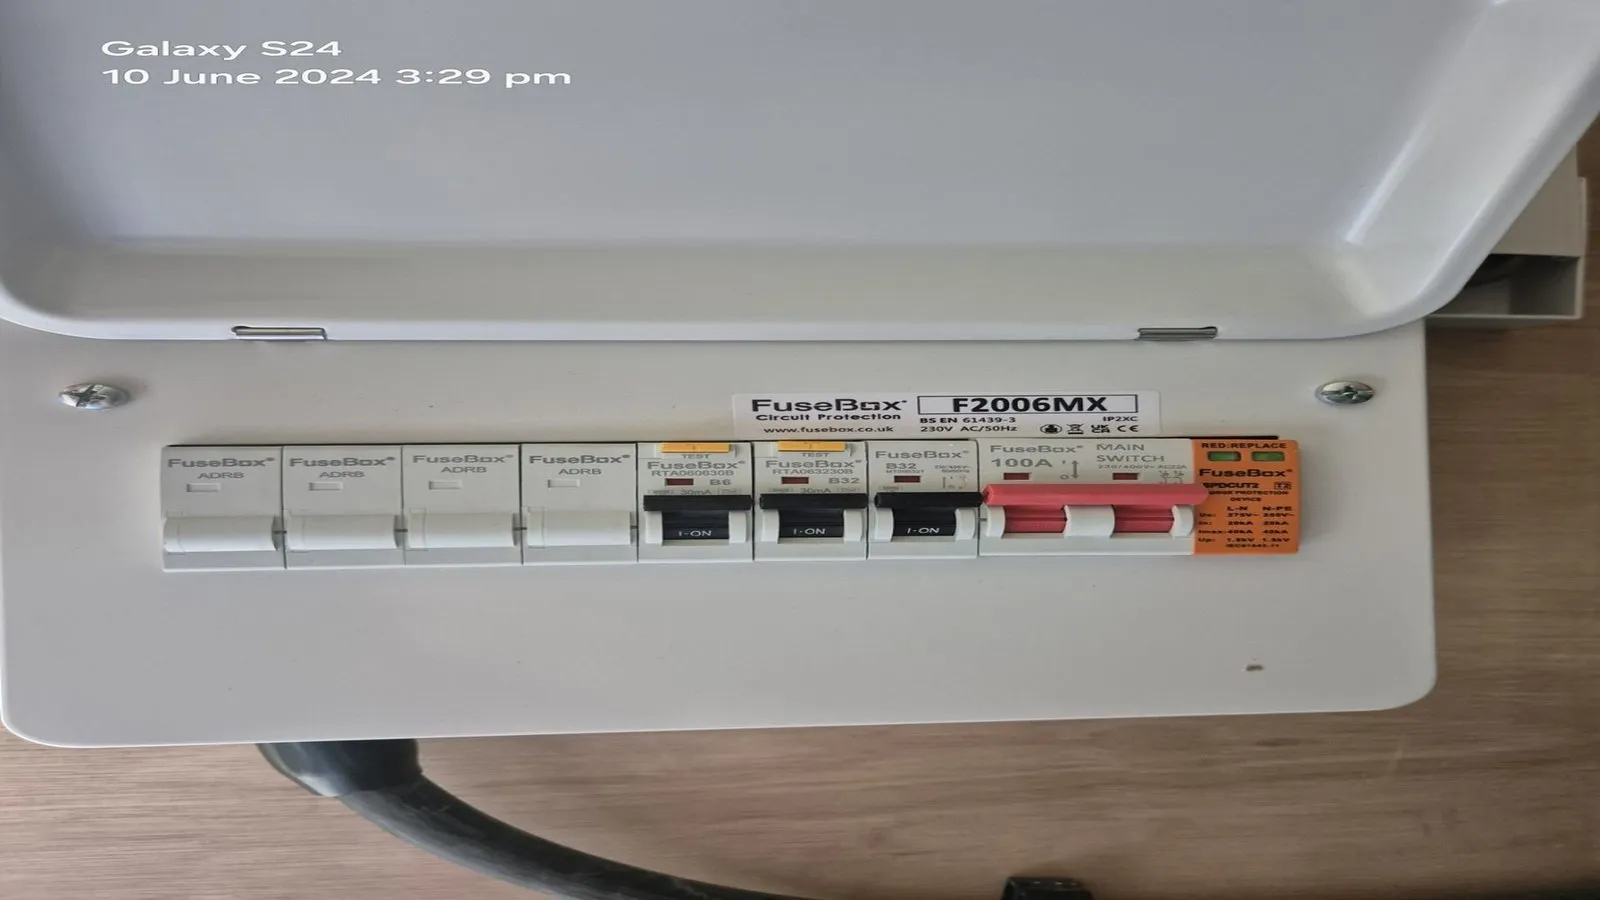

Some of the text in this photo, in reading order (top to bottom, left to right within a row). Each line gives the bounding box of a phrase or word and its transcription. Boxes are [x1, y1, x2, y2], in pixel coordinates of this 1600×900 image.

[751, 398, 902, 412] FuseBox
[952, 397, 1108, 412] F2006MX
[990, 445, 1077, 453] FuseBox
[413, 455, 506, 463] FuseBox
[875, 450, 962, 459] FuseBox
[168, 458, 266, 468] FuseBox
[289, 457, 387, 467] FuseBox
[529, 455, 622, 464] FuseBox
[991, 458, 1053, 468] 100A
[647, 461, 738, 470] FuseBox
[765, 460, 855, 469] FuseBox
[1199, 468, 1287, 477] FuseBox
